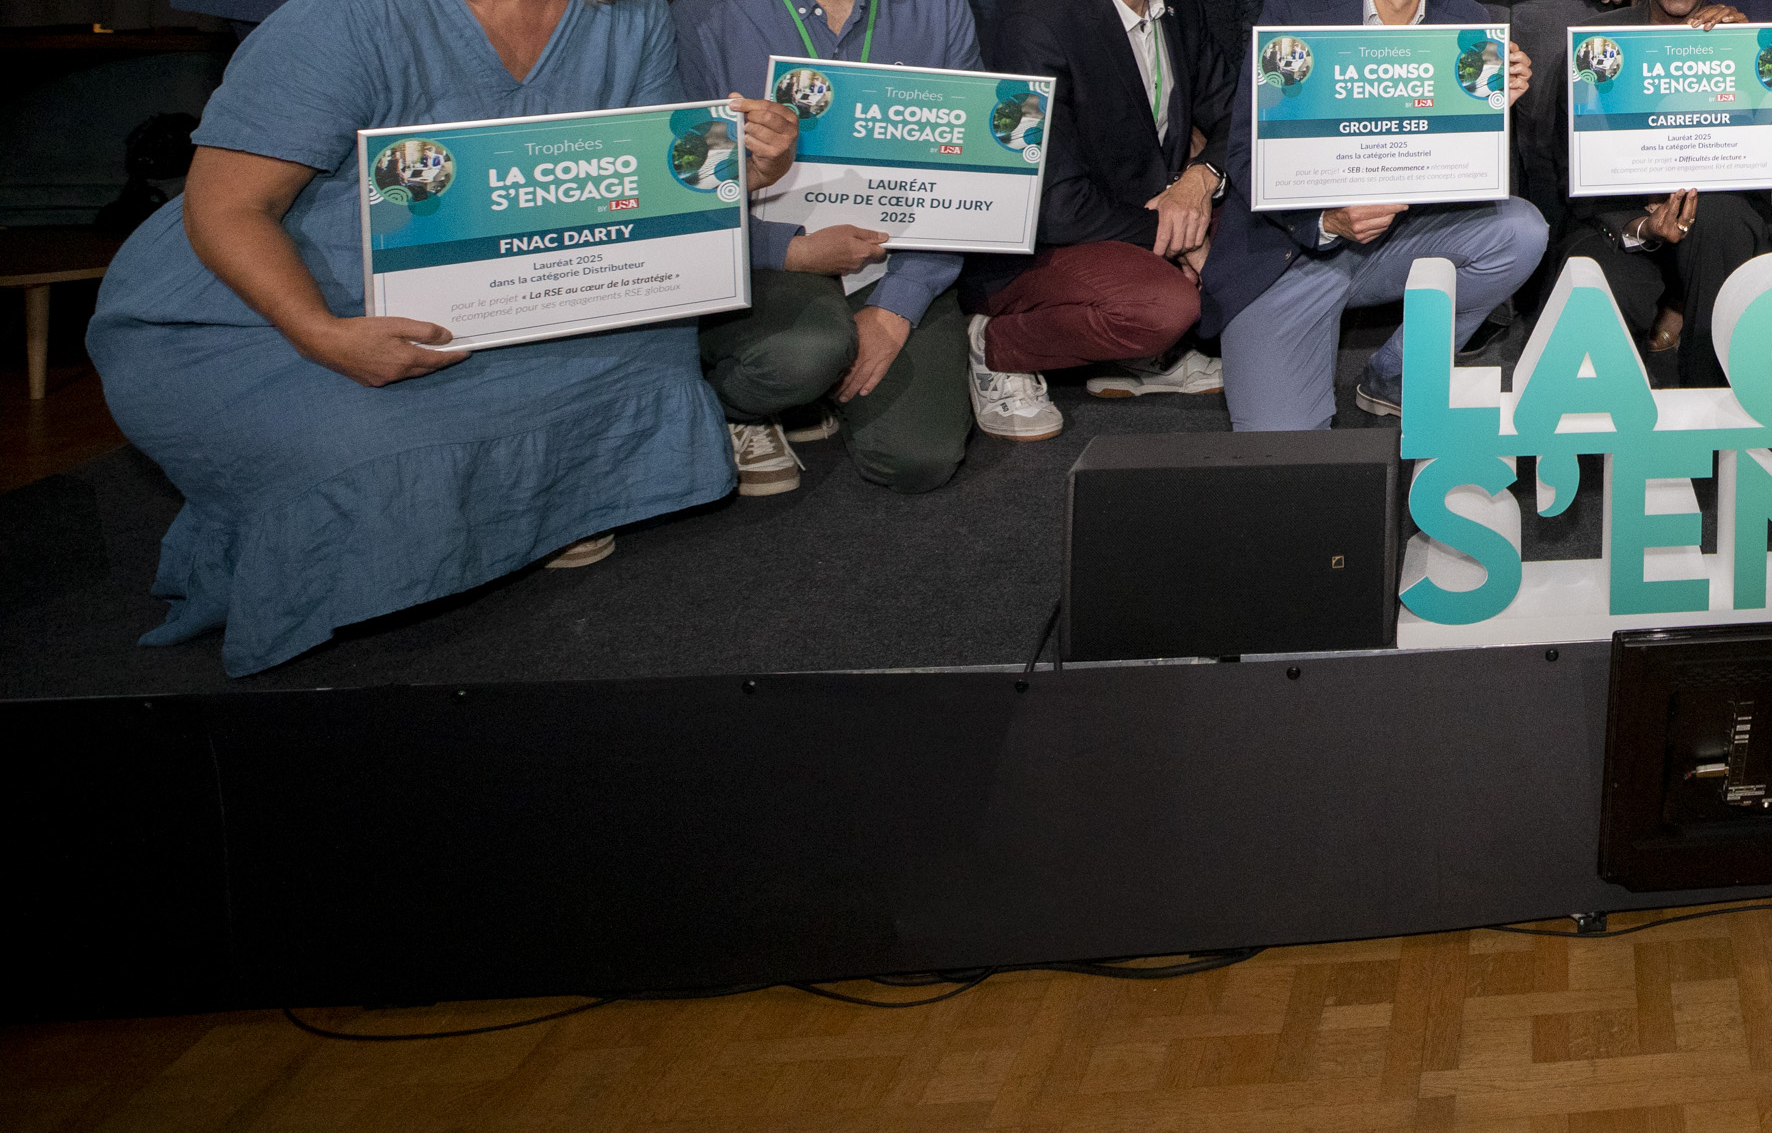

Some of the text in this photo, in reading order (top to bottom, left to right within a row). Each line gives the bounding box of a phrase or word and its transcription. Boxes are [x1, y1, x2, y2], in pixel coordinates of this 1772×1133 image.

[1334, 63, 1434, 80] LA CONSO
[1642, 60, 1736, 77] LA CONSO
[1334, 81, 1434, 99] S'ENGAGE
[1643, 77, 1736, 95] S'ENGAGE
[854, 104, 966, 124] LA CONSO
[1648, 113, 1730, 126] CARREFOUR
[853, 121, 965, 144] S'ENGAGE
[1339, 120, 1428, 134] GROUPE SEB
[525, 139, 603, 157] Trophées
[1360, 141, 1408, 150] Lauréat 2025
[1363, 151, 1396, 161] catégorie
[1398, 150, 1431, 158] Industriel
[488, 155, 637, 188] LA CONSO
[490, 176, 639, 211] S'ENGAGE
[868, 178, 937, 192] LAURÉAT
[610, 199, 639, 211] LSA
[804, 192, 849, 204] COUP
[853, 194, 873, 206] DE
[930, 198, 952, 209] DU
[956, 200, 993, 211] JURY
[880, 212, 916, 224] 2025
[500, 224, 634, 254] FNAC DARTY
[533, 253, 603, 271] Lauréat 2025
[490, 259, 645, 288] dans la catégorie Distributeur
[451, 300, 475, 313] pour
[478, 297, 487, 307] le
[490, 293, 518, 308] projet
[529, 288, 542, 300] La
[544, 286, 563, 297] RSE
[565, 286, 578, 295] au
[607, 279, 618, 290] de
[621, 278, 629, 288] la
[632, 271, 672, 288] stratégie
[1402, 286, 1658, 458] LA
